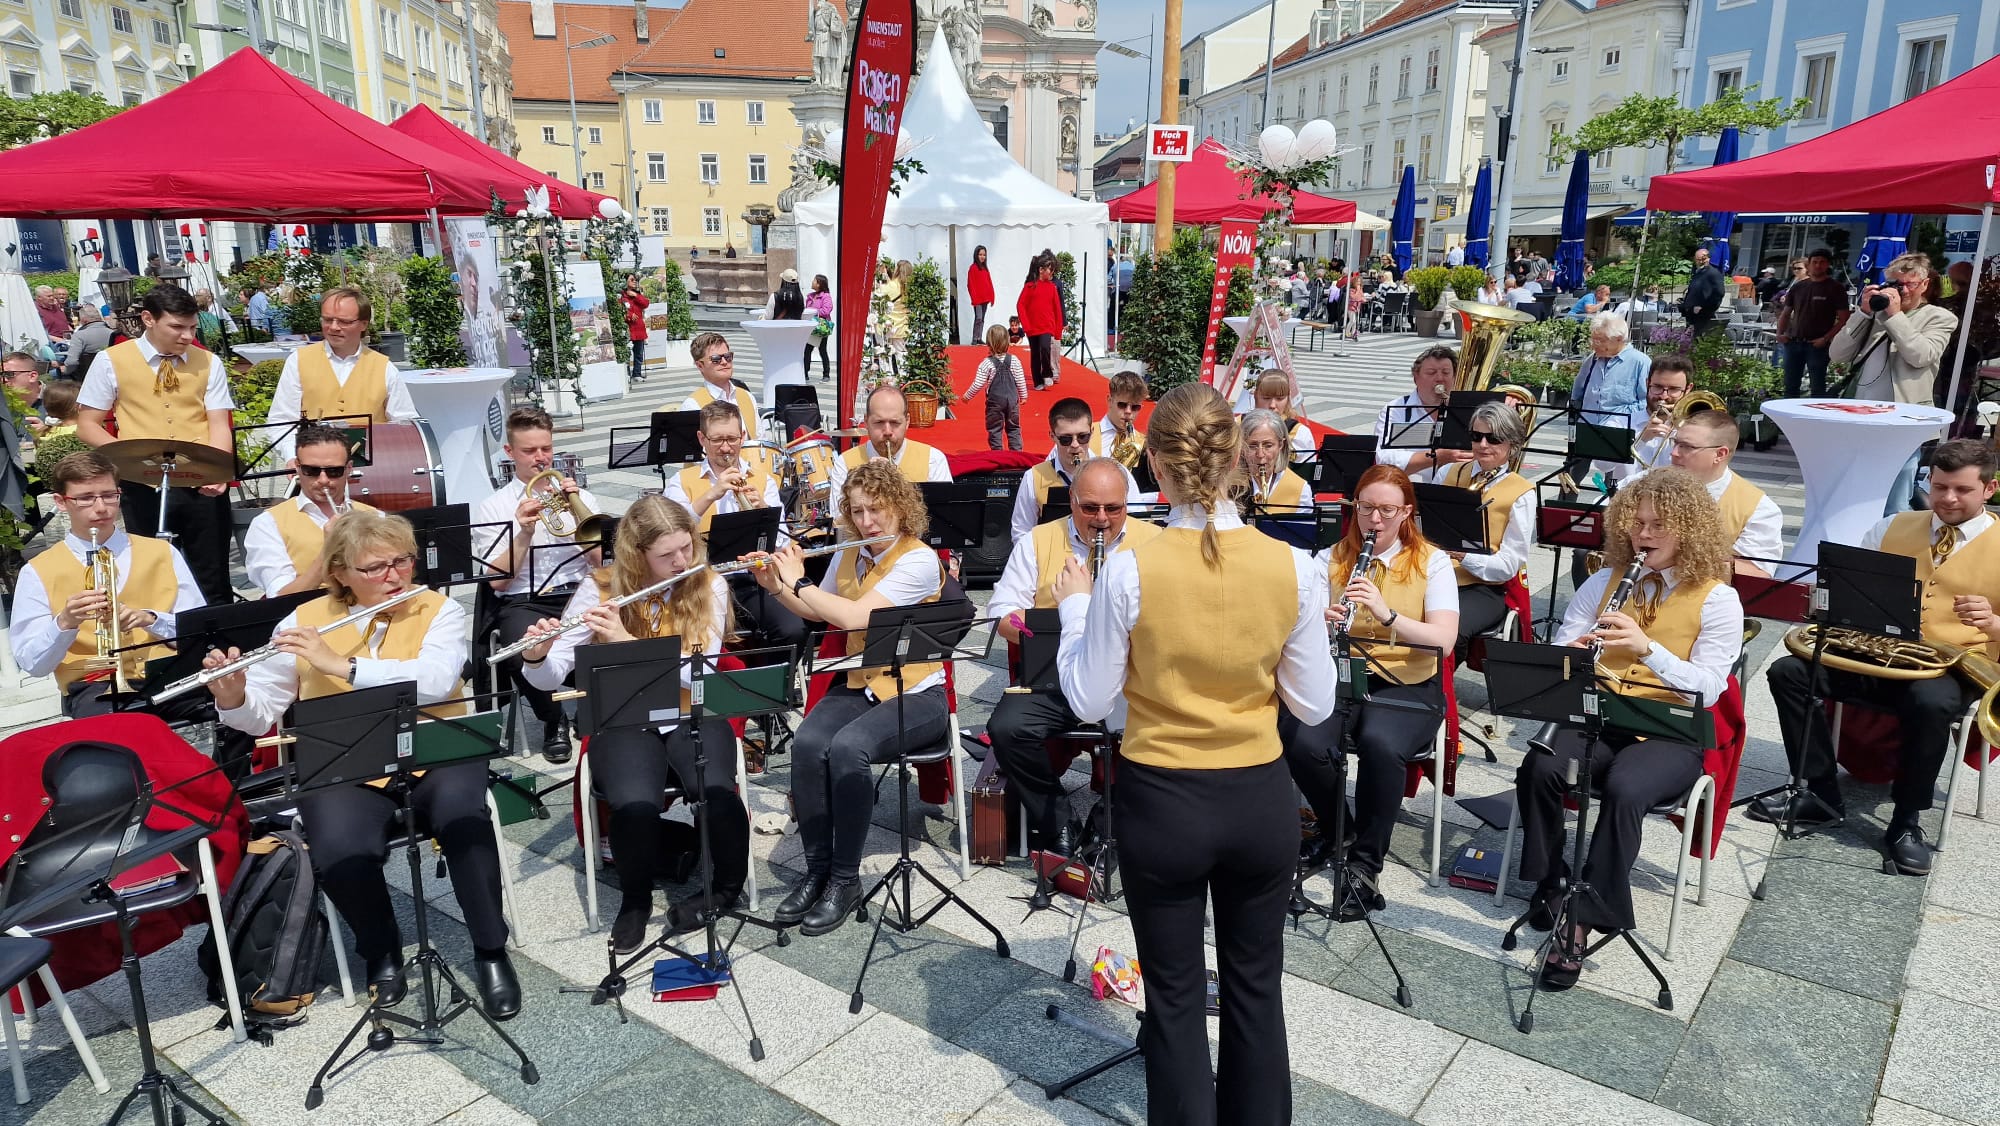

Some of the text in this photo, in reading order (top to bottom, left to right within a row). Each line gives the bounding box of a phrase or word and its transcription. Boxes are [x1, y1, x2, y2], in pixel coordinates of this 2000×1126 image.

[859, 59, 901, 102] Rosen
[1161, 130, 1181, 139] Hoch
[1156, 145, 1184, 155] 1. Mai
[1784, 215, 1828, 223] RHODOS
[1223, 229, 1252, 254] NÖN
